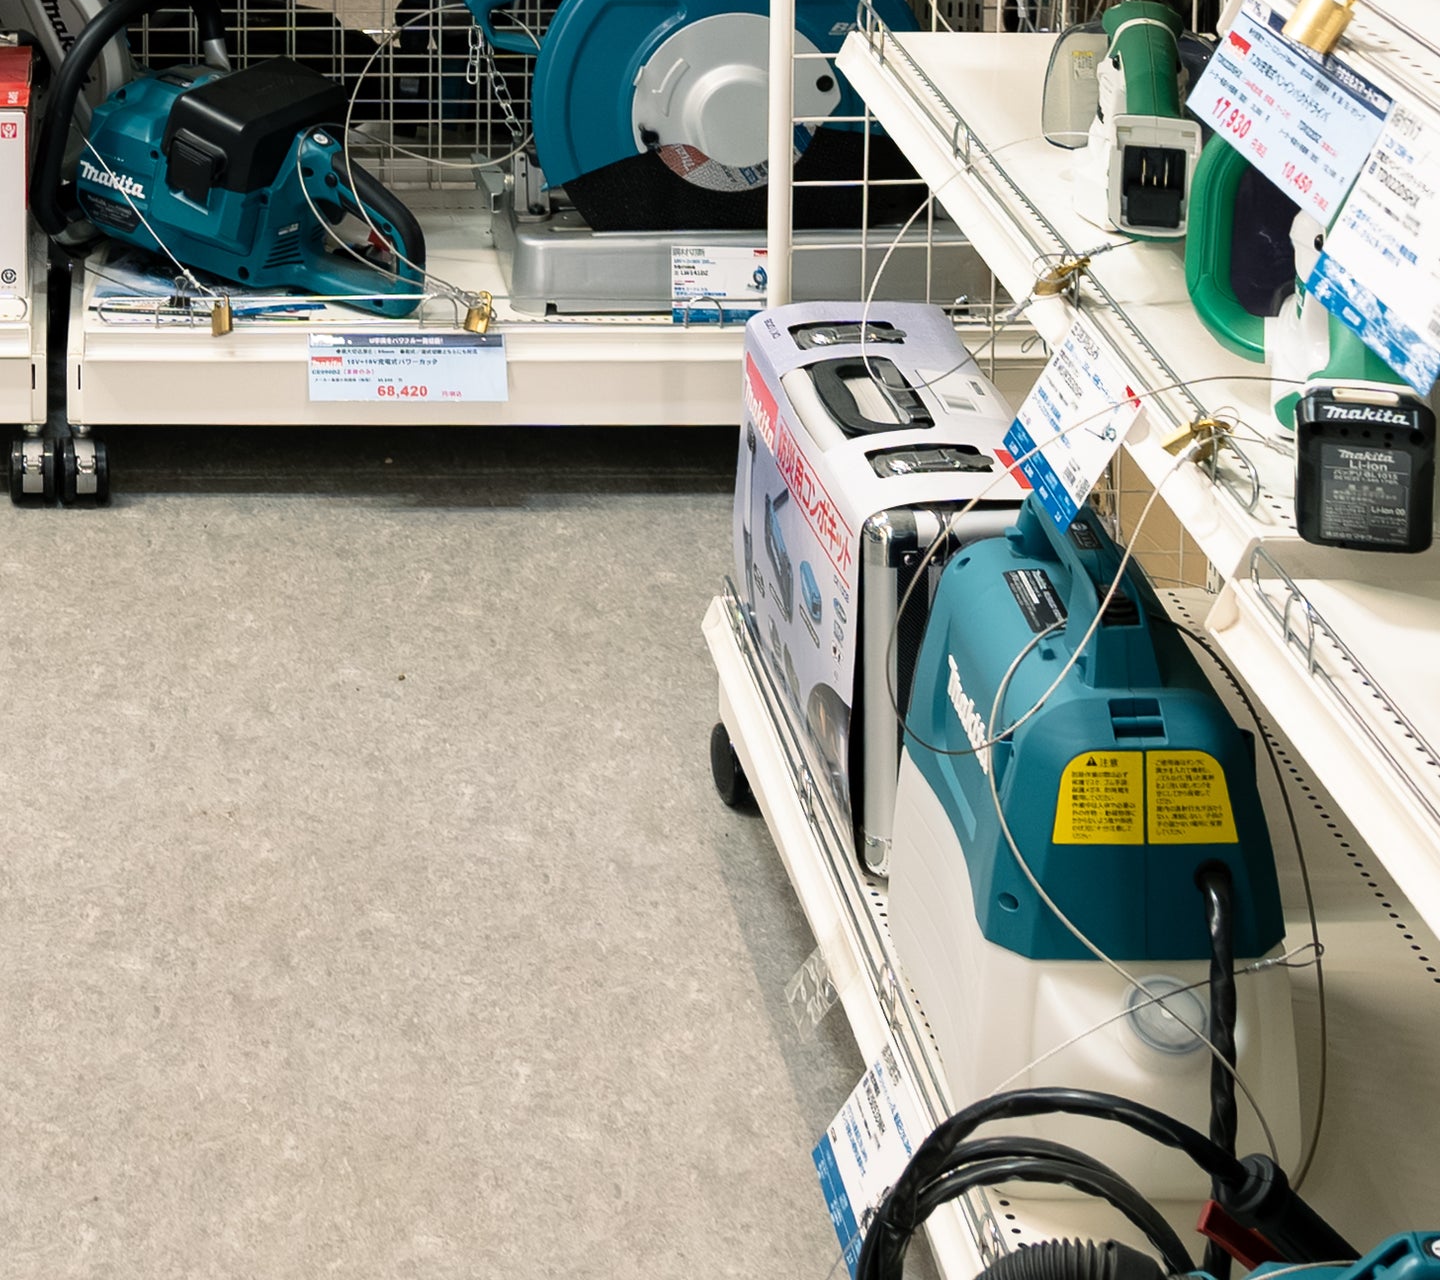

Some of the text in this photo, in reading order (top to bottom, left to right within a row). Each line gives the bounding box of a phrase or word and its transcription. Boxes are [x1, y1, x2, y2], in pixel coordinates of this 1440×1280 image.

[80, 161, 147, 201] Makita
[377, 385, 429, 398] 68,420
[1322, 404, 1411, 427] Makita
[1337, 448, 1395, 464] Makita
